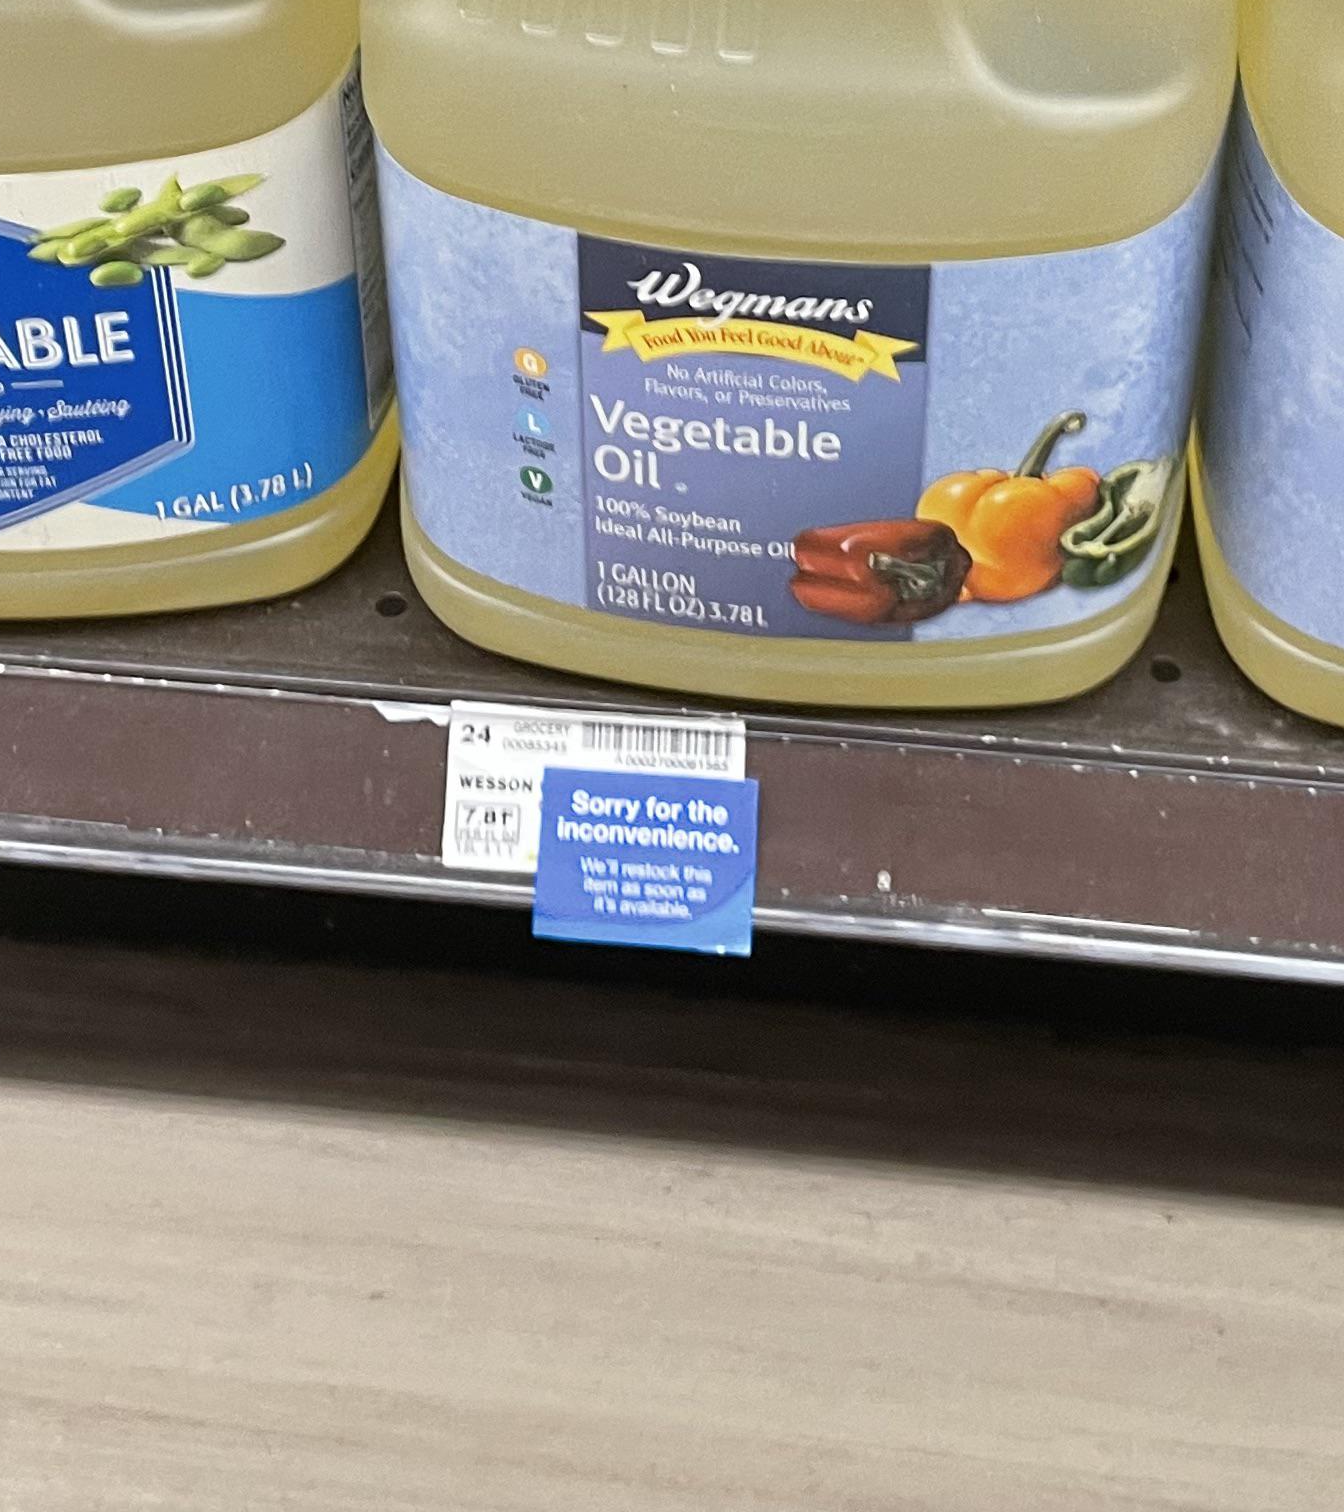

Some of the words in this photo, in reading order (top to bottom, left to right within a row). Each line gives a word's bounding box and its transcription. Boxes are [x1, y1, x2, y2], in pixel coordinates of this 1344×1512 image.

[626, 262, 874, 329] Wegmans
[641, 328, 683, 351] Food
[686, 325, 717, 345] You
[721, 326, 752, 344] Feel
[757, 331, 803, 351] Good
[645, 377, 707, 404] Flavors,
[715, 390, 732, 404] or
[739, 389, 851, 413] Preservatives
[667, 363, 689, 379] No
[694, 366, 762, 390] Artificial
[769, 375, 827, 394] Colors,
[8, 429, 105, 450] CHOLESTEROL
[589, 393, 842, 461] Vegetable
[37, 445, 73, 461] FOOD
[593, 444, 661, 490] Oil
[155, 499, 166, 522] 1
[172, 489, 224, 519] GAL
[230, 472, 287, 513] (3.78
[595, 495, 651, 520] 100%
[655, 505, 741, 535] Soybean
[595, 515, 643, 543] Ideal
[648, 527, 763, 557] All-Purpose
[767, 541, 797, 562] Oil
[611, 563, 696, 596] GALLON
[597, 580, 639, 609] (128
[643, 590, 665, 614] FL
[669, 595, 705, 621] OZ)
[709, 601, 753, 627] 3.78
[462, 724, 491, 744] 24
[460, 774, 533, 792] WESSON
[571, 789, 641, 823] Sorry
[646, 796, 683, 822] for
[687, 799, 728, 826] the
[557, 815, 740, 854] inconvenience.
[580, 855, 619, 878] We'll
[621, 862, 681, 881] restock
[683, 864, 713, 886] this
[583, 874, 618, 894] item
[621, 881, 641, 897] as
[644, 883, 684, 901] soon
[687, 887, 706, 903] as
